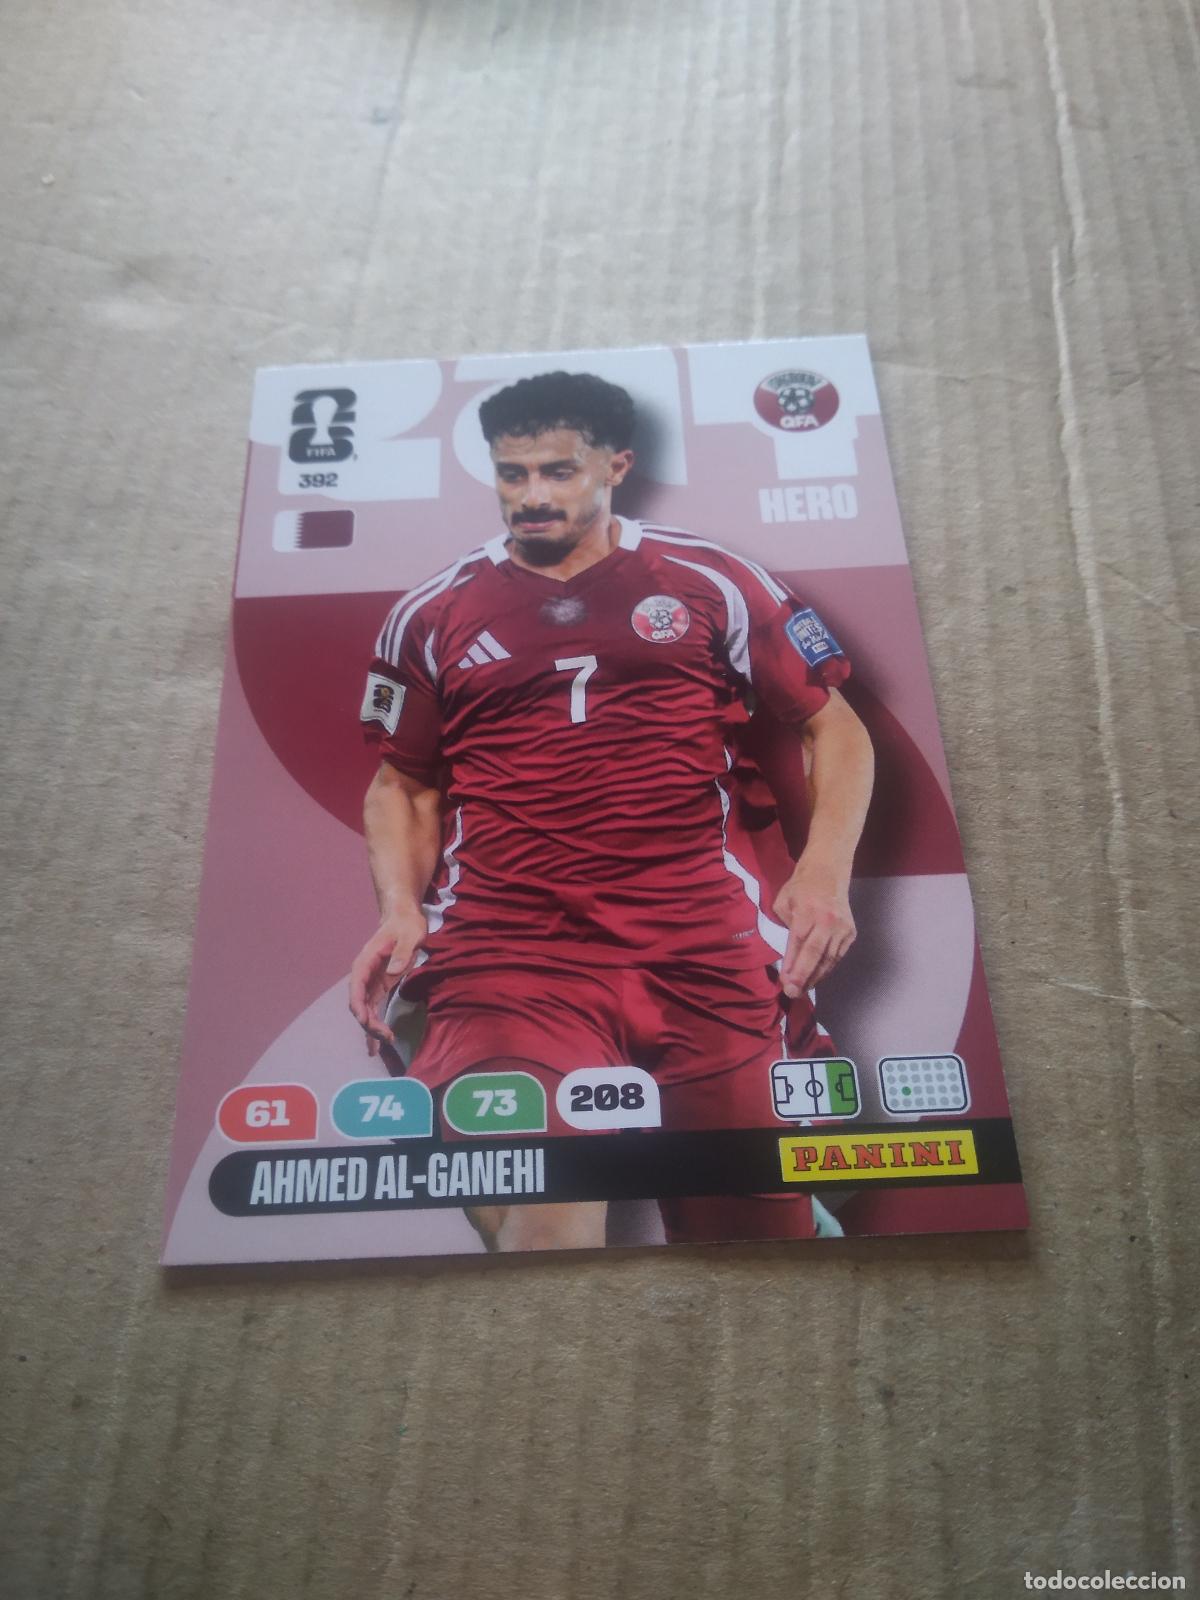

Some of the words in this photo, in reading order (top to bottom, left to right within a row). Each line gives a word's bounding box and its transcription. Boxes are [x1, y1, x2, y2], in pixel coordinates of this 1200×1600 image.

[306, 447, 336, 457] FIFA
[298, 472, 339, 488] 392
[758, 483, 858, 523] HERO
[554, 655, 598, 723] 7
[359, 1094, 404, 1123] 74
[472, 1088, 518, 1118] 73
[570, 1082, 645, 1113] 208
[245, 1099, 290, 1128] 61
[791, 1140, 966, 1172] PANINI
[250, 1157, 368, 1205] AHMED
[374, 1148, 545, 1200] AL-GANEHI
